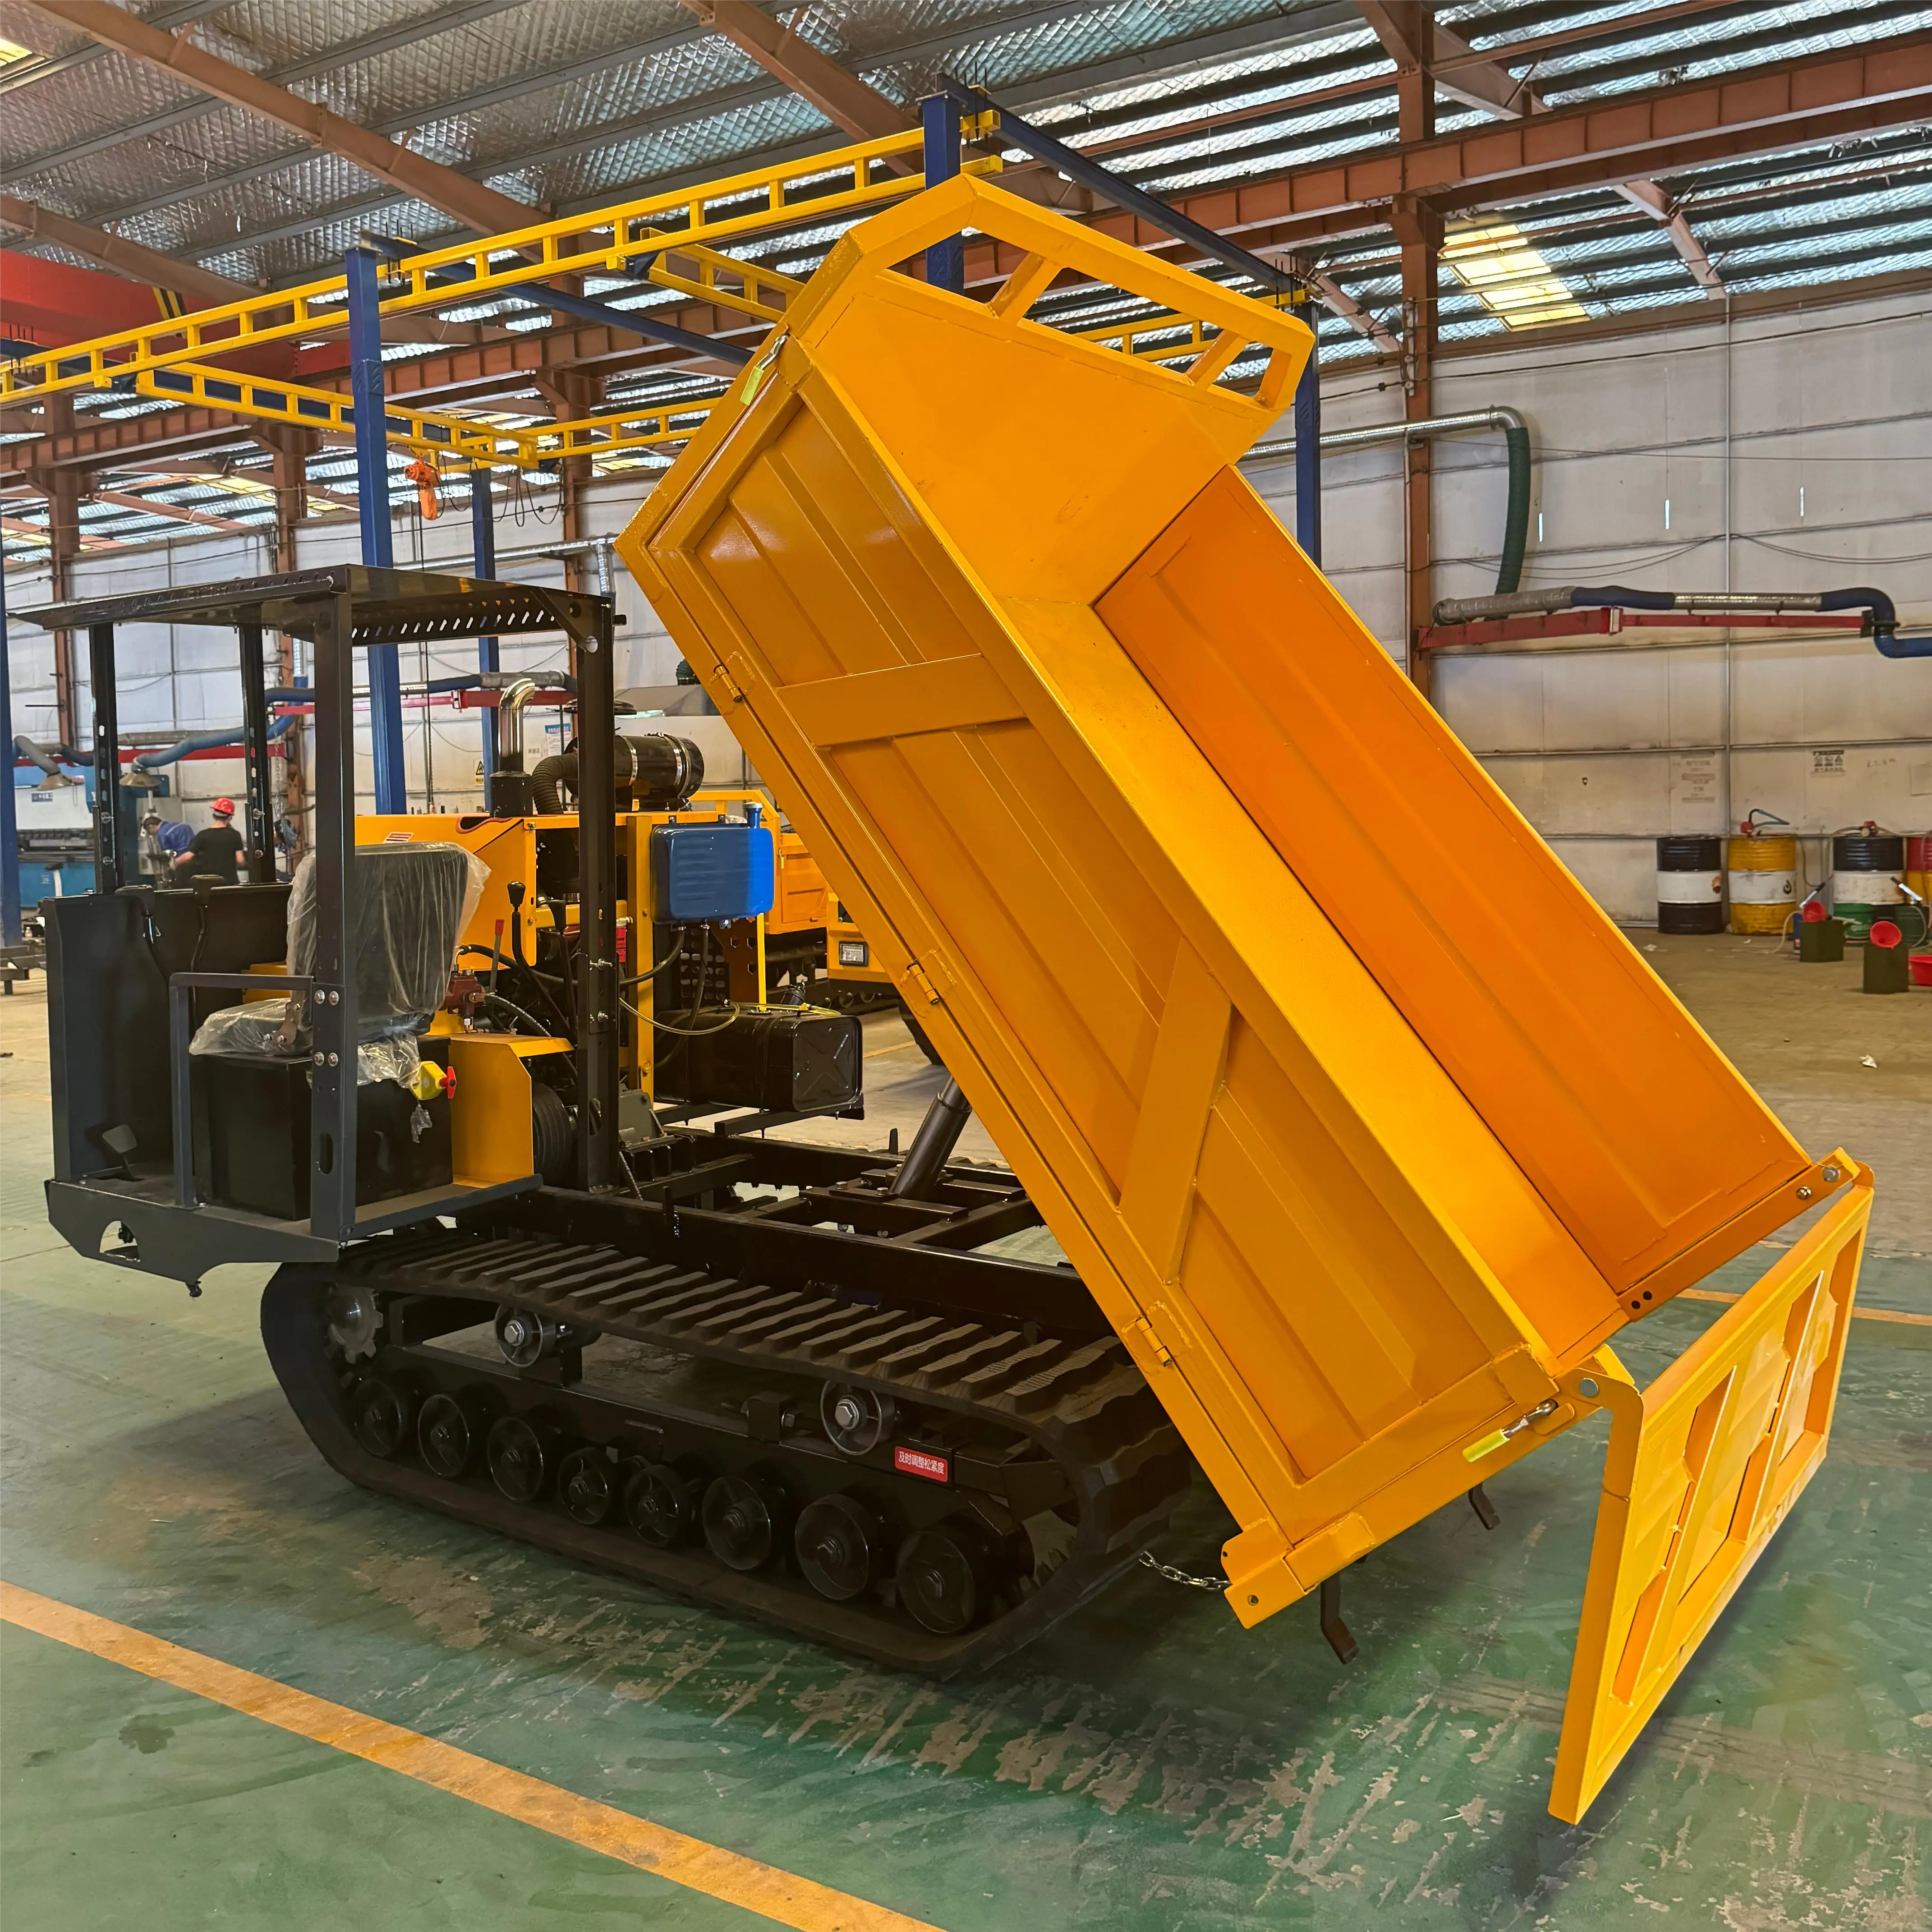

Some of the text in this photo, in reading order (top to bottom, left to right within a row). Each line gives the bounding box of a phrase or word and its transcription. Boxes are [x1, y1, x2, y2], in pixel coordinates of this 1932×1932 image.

[898, 1451, 944, 1475] 及时调整松紧度
